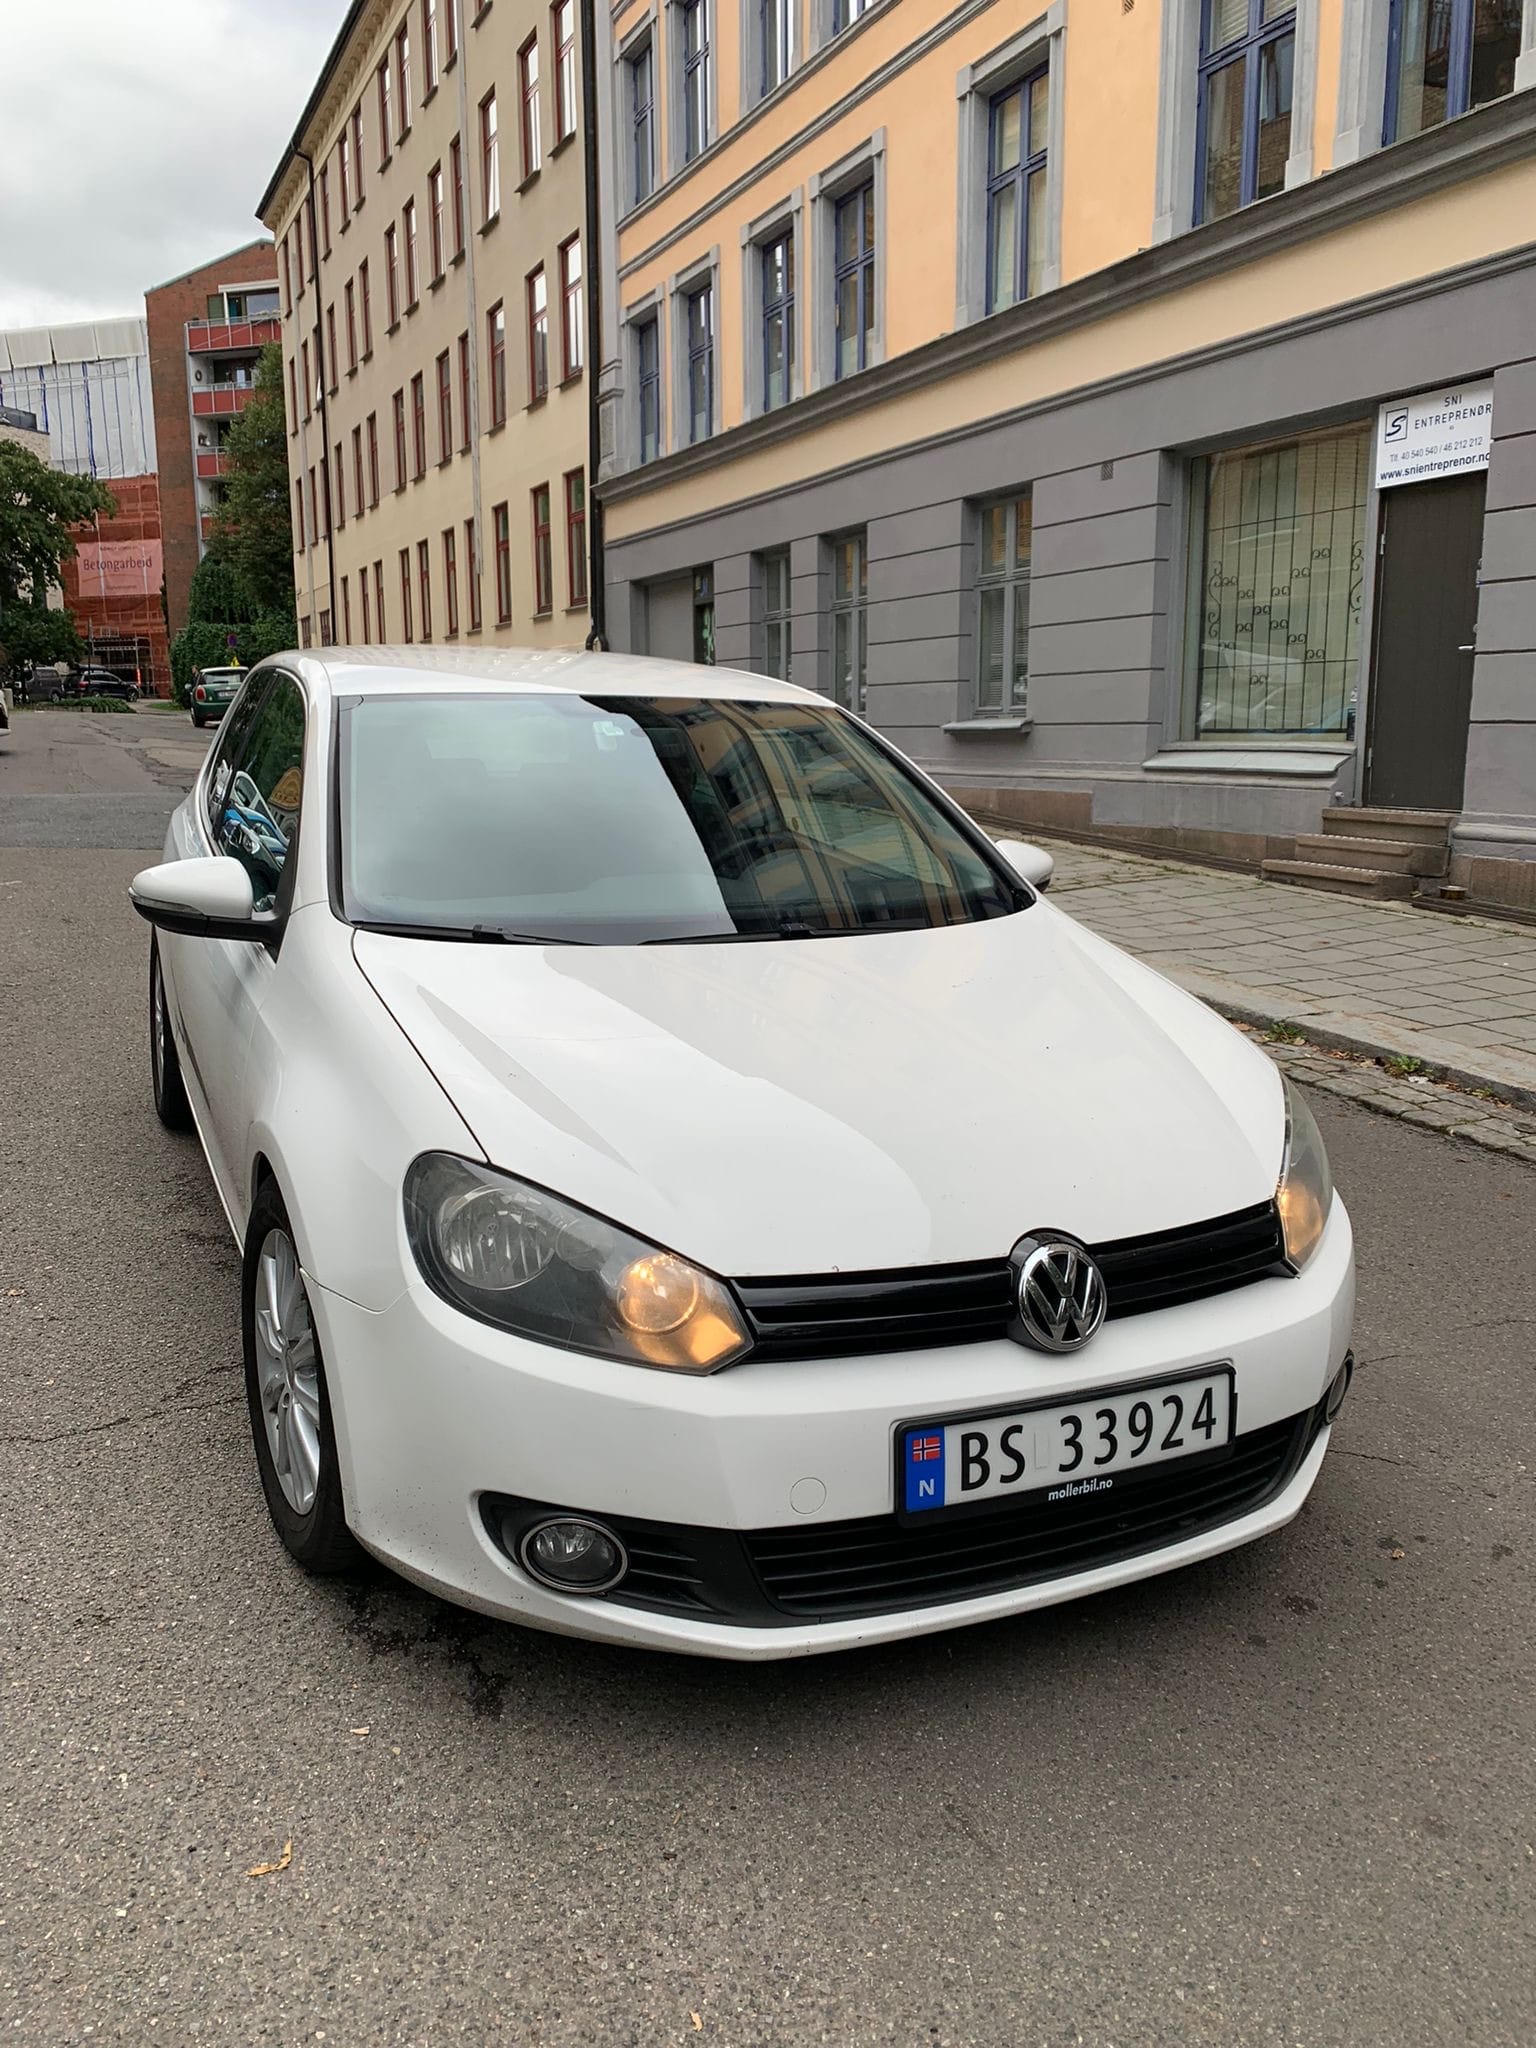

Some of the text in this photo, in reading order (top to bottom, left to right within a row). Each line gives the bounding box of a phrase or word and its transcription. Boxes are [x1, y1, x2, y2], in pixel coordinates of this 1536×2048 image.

[1444, 394, 1462, 407] SNI
[1414, 403, 1492, 429] ENTREPRENØR
[1411, 447, 1424, 459] 540
[1425, 445, 1438, 456] 540
[1454, 439, 1468, 450] 212
[1469, 436, 1483, 447] 212
[83, 556, 152, 572] Betongarbeid
[960, 1386, 1217, 1492] BS 33924
[918, 1478, 935, 1498] N
[1048, 1477, 1113, 1502] mollerbil.no
